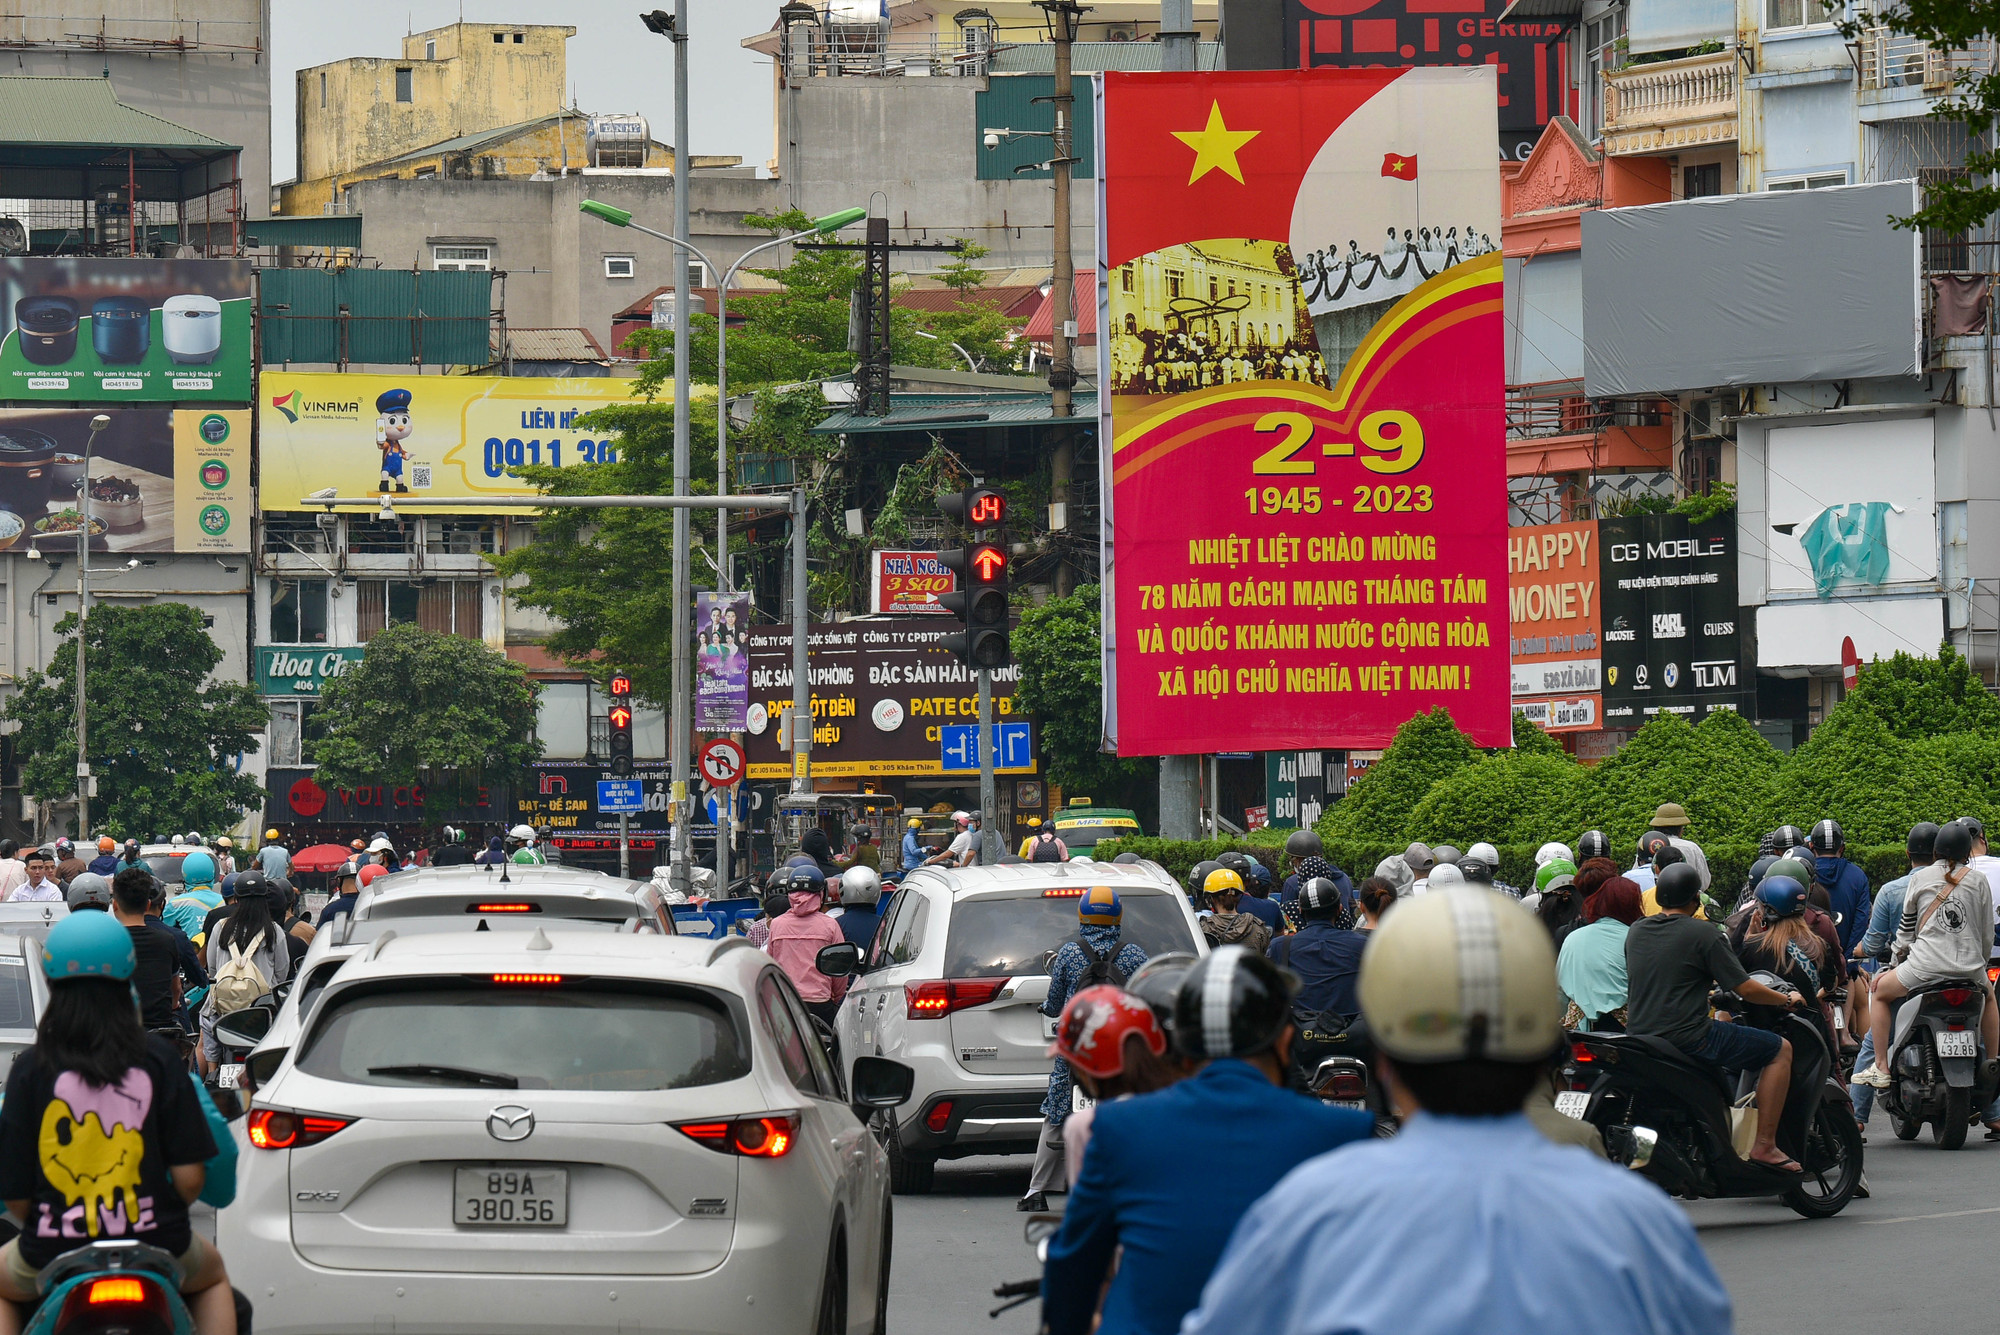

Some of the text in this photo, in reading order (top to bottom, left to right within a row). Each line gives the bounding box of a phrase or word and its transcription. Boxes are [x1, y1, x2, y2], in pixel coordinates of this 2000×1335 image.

[302, 401, 359, 413] VINAMA
[521, 407, 555, 429] LIÊN
[1253, 410, 1426, 476] 2-9
[1244, 486, 1322, 515] 1945
[1353, 484, 1434, 513] 2023
[1189, 531, 1437, 569] NHIỆT LIỆT CHÀO MỪNG
[1509, 530, 1591, 574] HAPPY
[1611, 537, 1725, 563] CG MOBILE
[885, 554, 915, 575] NHÀ
[886, 577, 949, 591] 3 SAO
[1138, 573, 1487, 611] 78 NĂM CÁCH MẠNG THÁNG TÁM
[1618, 579, 1631, 591] PHỤ
[1631, 576, 1646, 590] KIỆN
[1680, 573, 1700, 585] CHÍNH
[1510, 581, 1595, 623] MONEY
[1652, 612, 1686, 632] KARL
[1703, 622, 1735, 636] GUESS
[749, 634, 778, 647] CÔNG TY
[824, 630, 841, 645] SỐNG
[842, 631, 858, 646] VIỆT
[862, 630, 905, 643] CÔNG TY
[1137, 626, 1165, 654] VÀ
[1171, 616, 1229, 653] QUỐC
[1235, 619, 1309, 650] KHÁNH
[1315, 617, 1374, 649] NƯỚC
[1380, 617, 1440, 653] CỘNG
[1446, 616, 1490, 647] HÒA
[1548, 632, 1572, 653] TOÀN
[1573, 627, 1597, 653] QUỐC
[1605, 630, 1636, 642] LACOSTE
[269, 652, 314, 677] Hoa
[869, 659, 967, 687] ĐẶC SẢN HẢI
[1691, 660, 1736, 688] TUMI
[293, 680, 314, 691] 406
[612, 679, 630, 695] 04
[752, 665, 773, 691] ĐẶC
[774, 663, 794, 687] SẢN
[817, 663, 854, 686] PHÒNG
[1158, 659, 1461, 700] XÃ HỘI CHỦ NGHĨA VIỆT NAM
[1543, 672, 1560, 690] 526
[829, 693, 856, 717] ĐÈN
[881, 707, 899, 720] HBL
[910, 698, 956, 716] PATE
[1525, 705, 1546, 719] NHANH
[1558, 703, 1588, 724] BẢO HIỂM
[752, 711, 764, 723] HBL
[813, 722, 840, 747] HIỆU
[649, 769, 669, 779] THIẾT
[916, 763, 935, 771] Thiên
[539, 772, 568, 795] in
[518, 800, 539, 814] BẠT
[550, 816, 578, 827] NGAY
[1943, 1033, 1970, 1044] 29-L1
[1941, 1044, 1974, 1056] 432.86
[487, 1172, 534, 1195] 89A
[466, 1198, 553, 1222] 380.56
